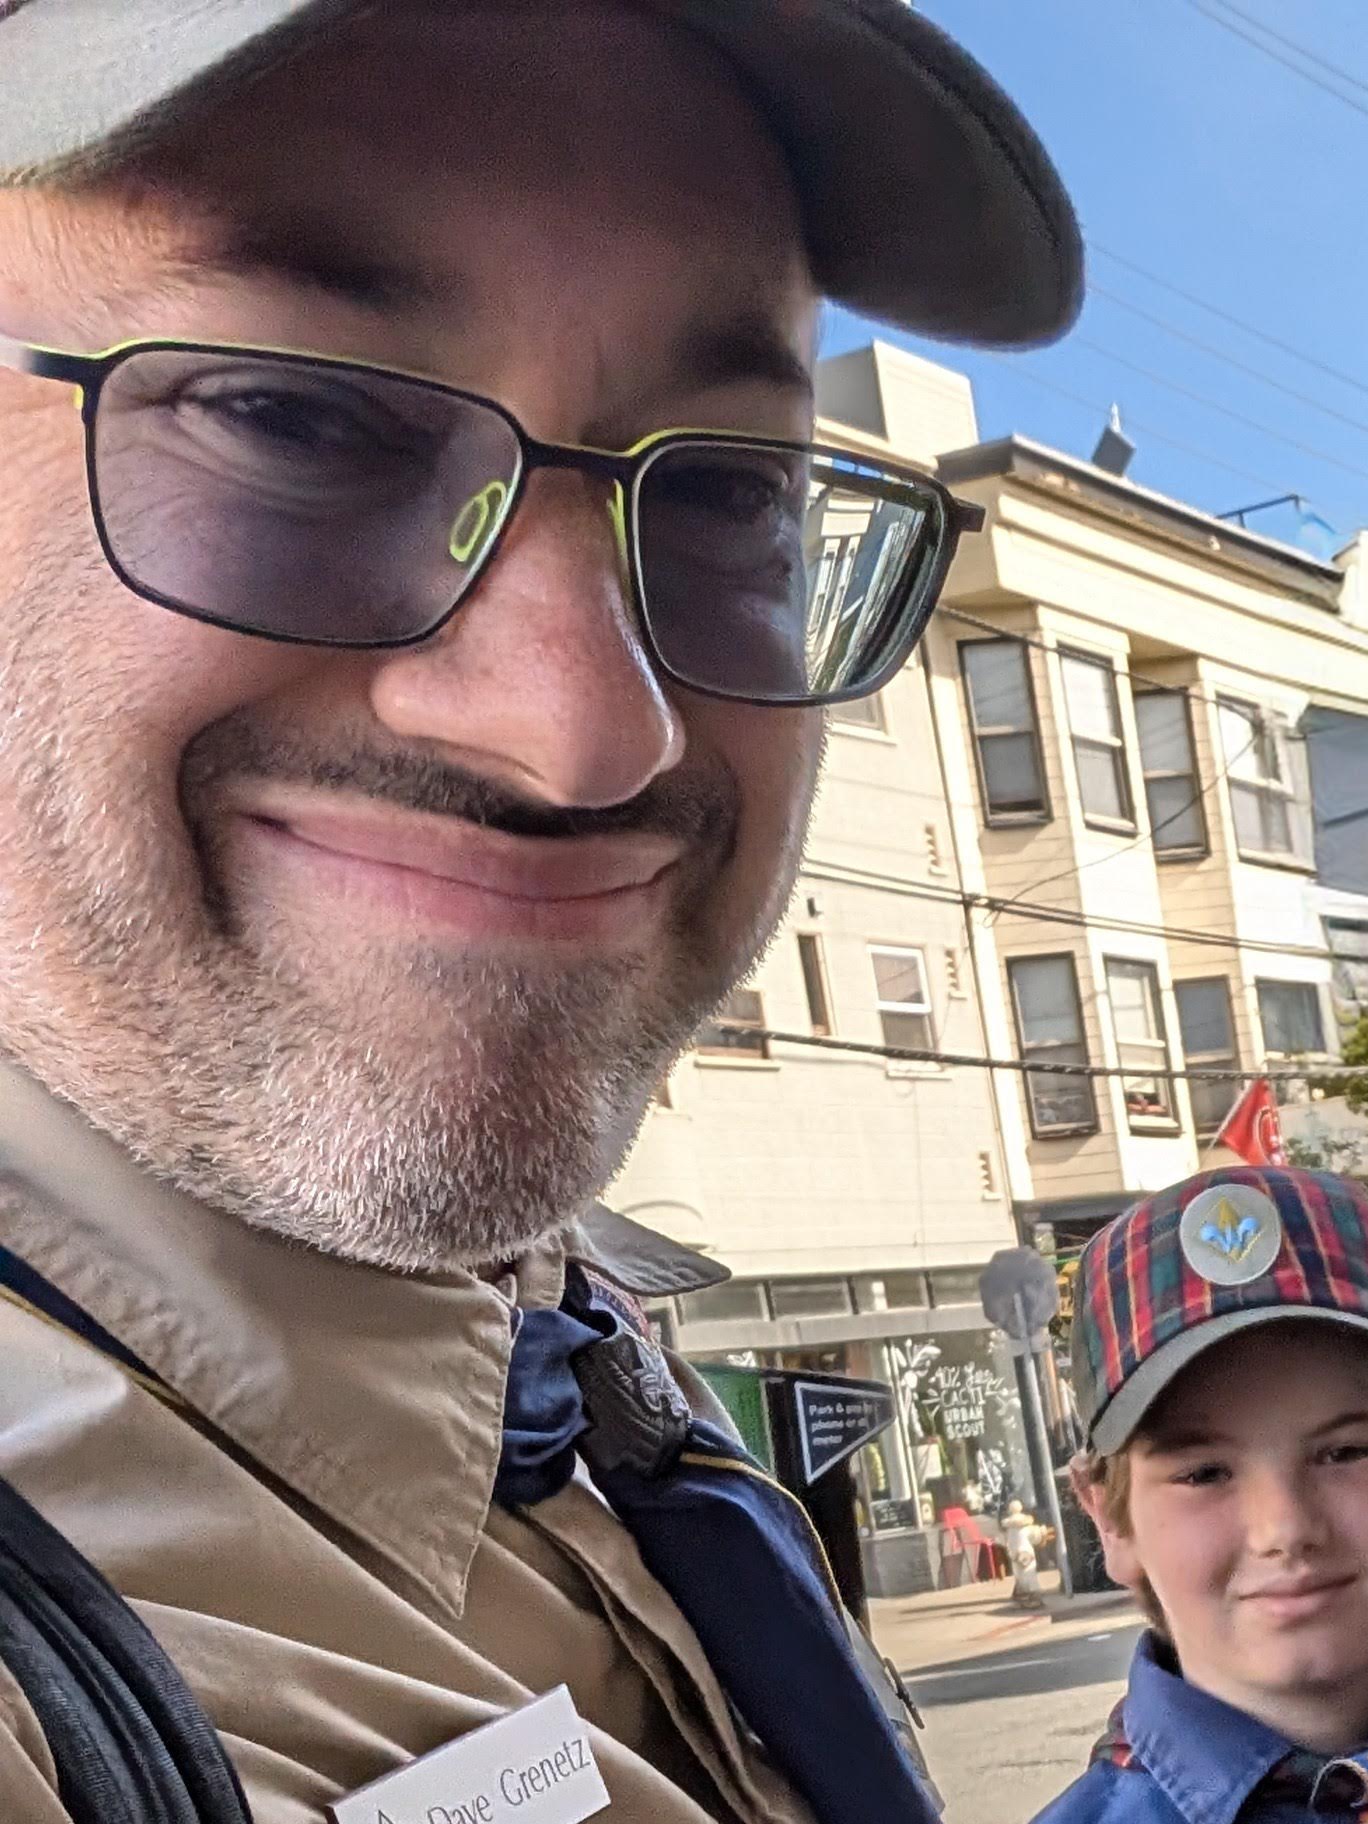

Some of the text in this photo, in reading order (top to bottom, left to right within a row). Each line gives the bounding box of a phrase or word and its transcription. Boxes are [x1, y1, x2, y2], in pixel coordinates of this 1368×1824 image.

[943, 1405, 985, 1425] URBAN
[946, 1419, 985, 1439] SCOUT
[499, 1738, 592, 1807] Grenetz
